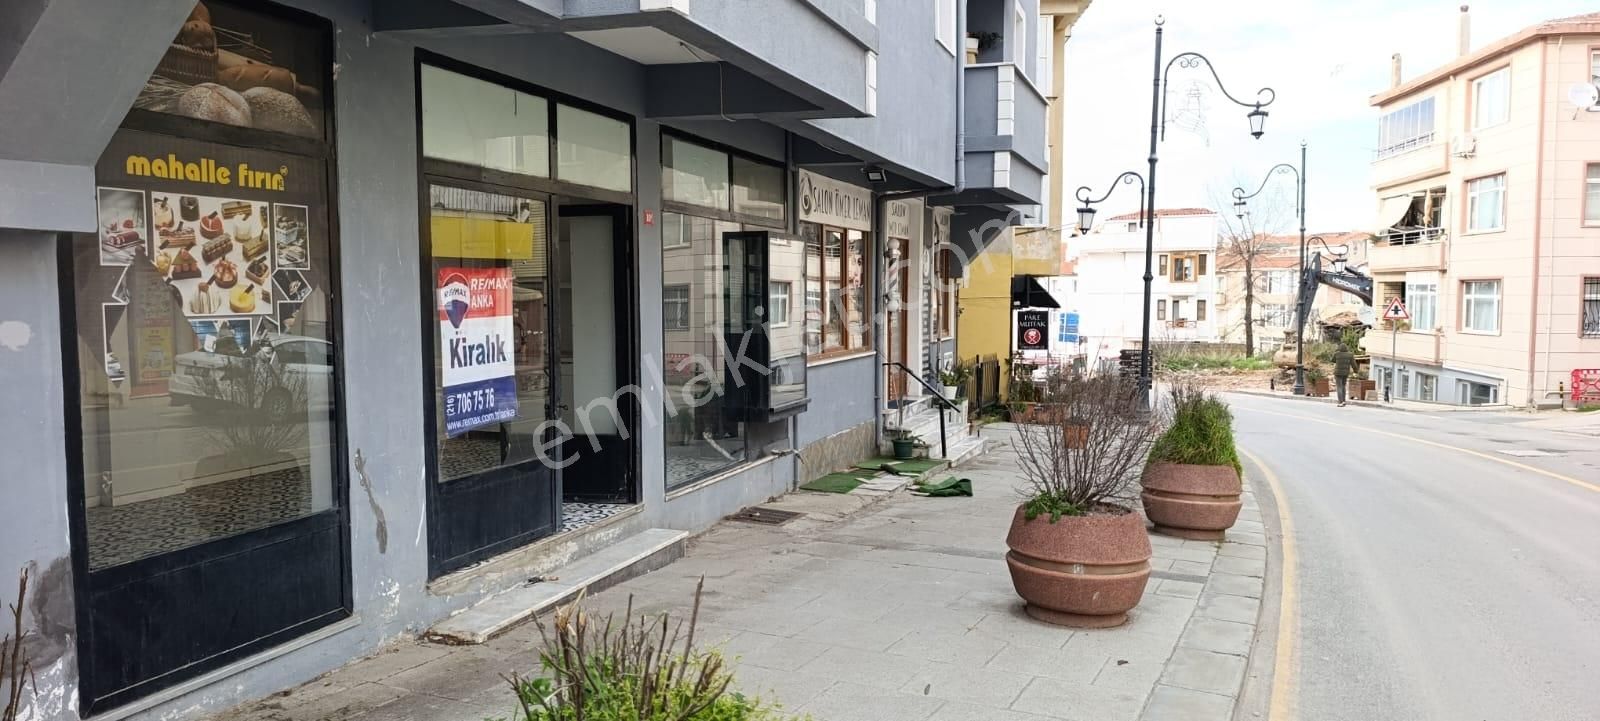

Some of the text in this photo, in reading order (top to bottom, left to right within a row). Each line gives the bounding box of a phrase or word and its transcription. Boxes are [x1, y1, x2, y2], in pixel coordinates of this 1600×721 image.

[126, 154, 231, 185] mahalle
[813, 186, 833, 216] SALON
[444, 288, 467, 298] RE/MAX
[470, 277, 509, 291] RE/MAX
[471, 294, 494, 309] ANKA
[449, 333, 508, 369] Kiralık
[446, 388, 495, 417] (216) 706 75 76
